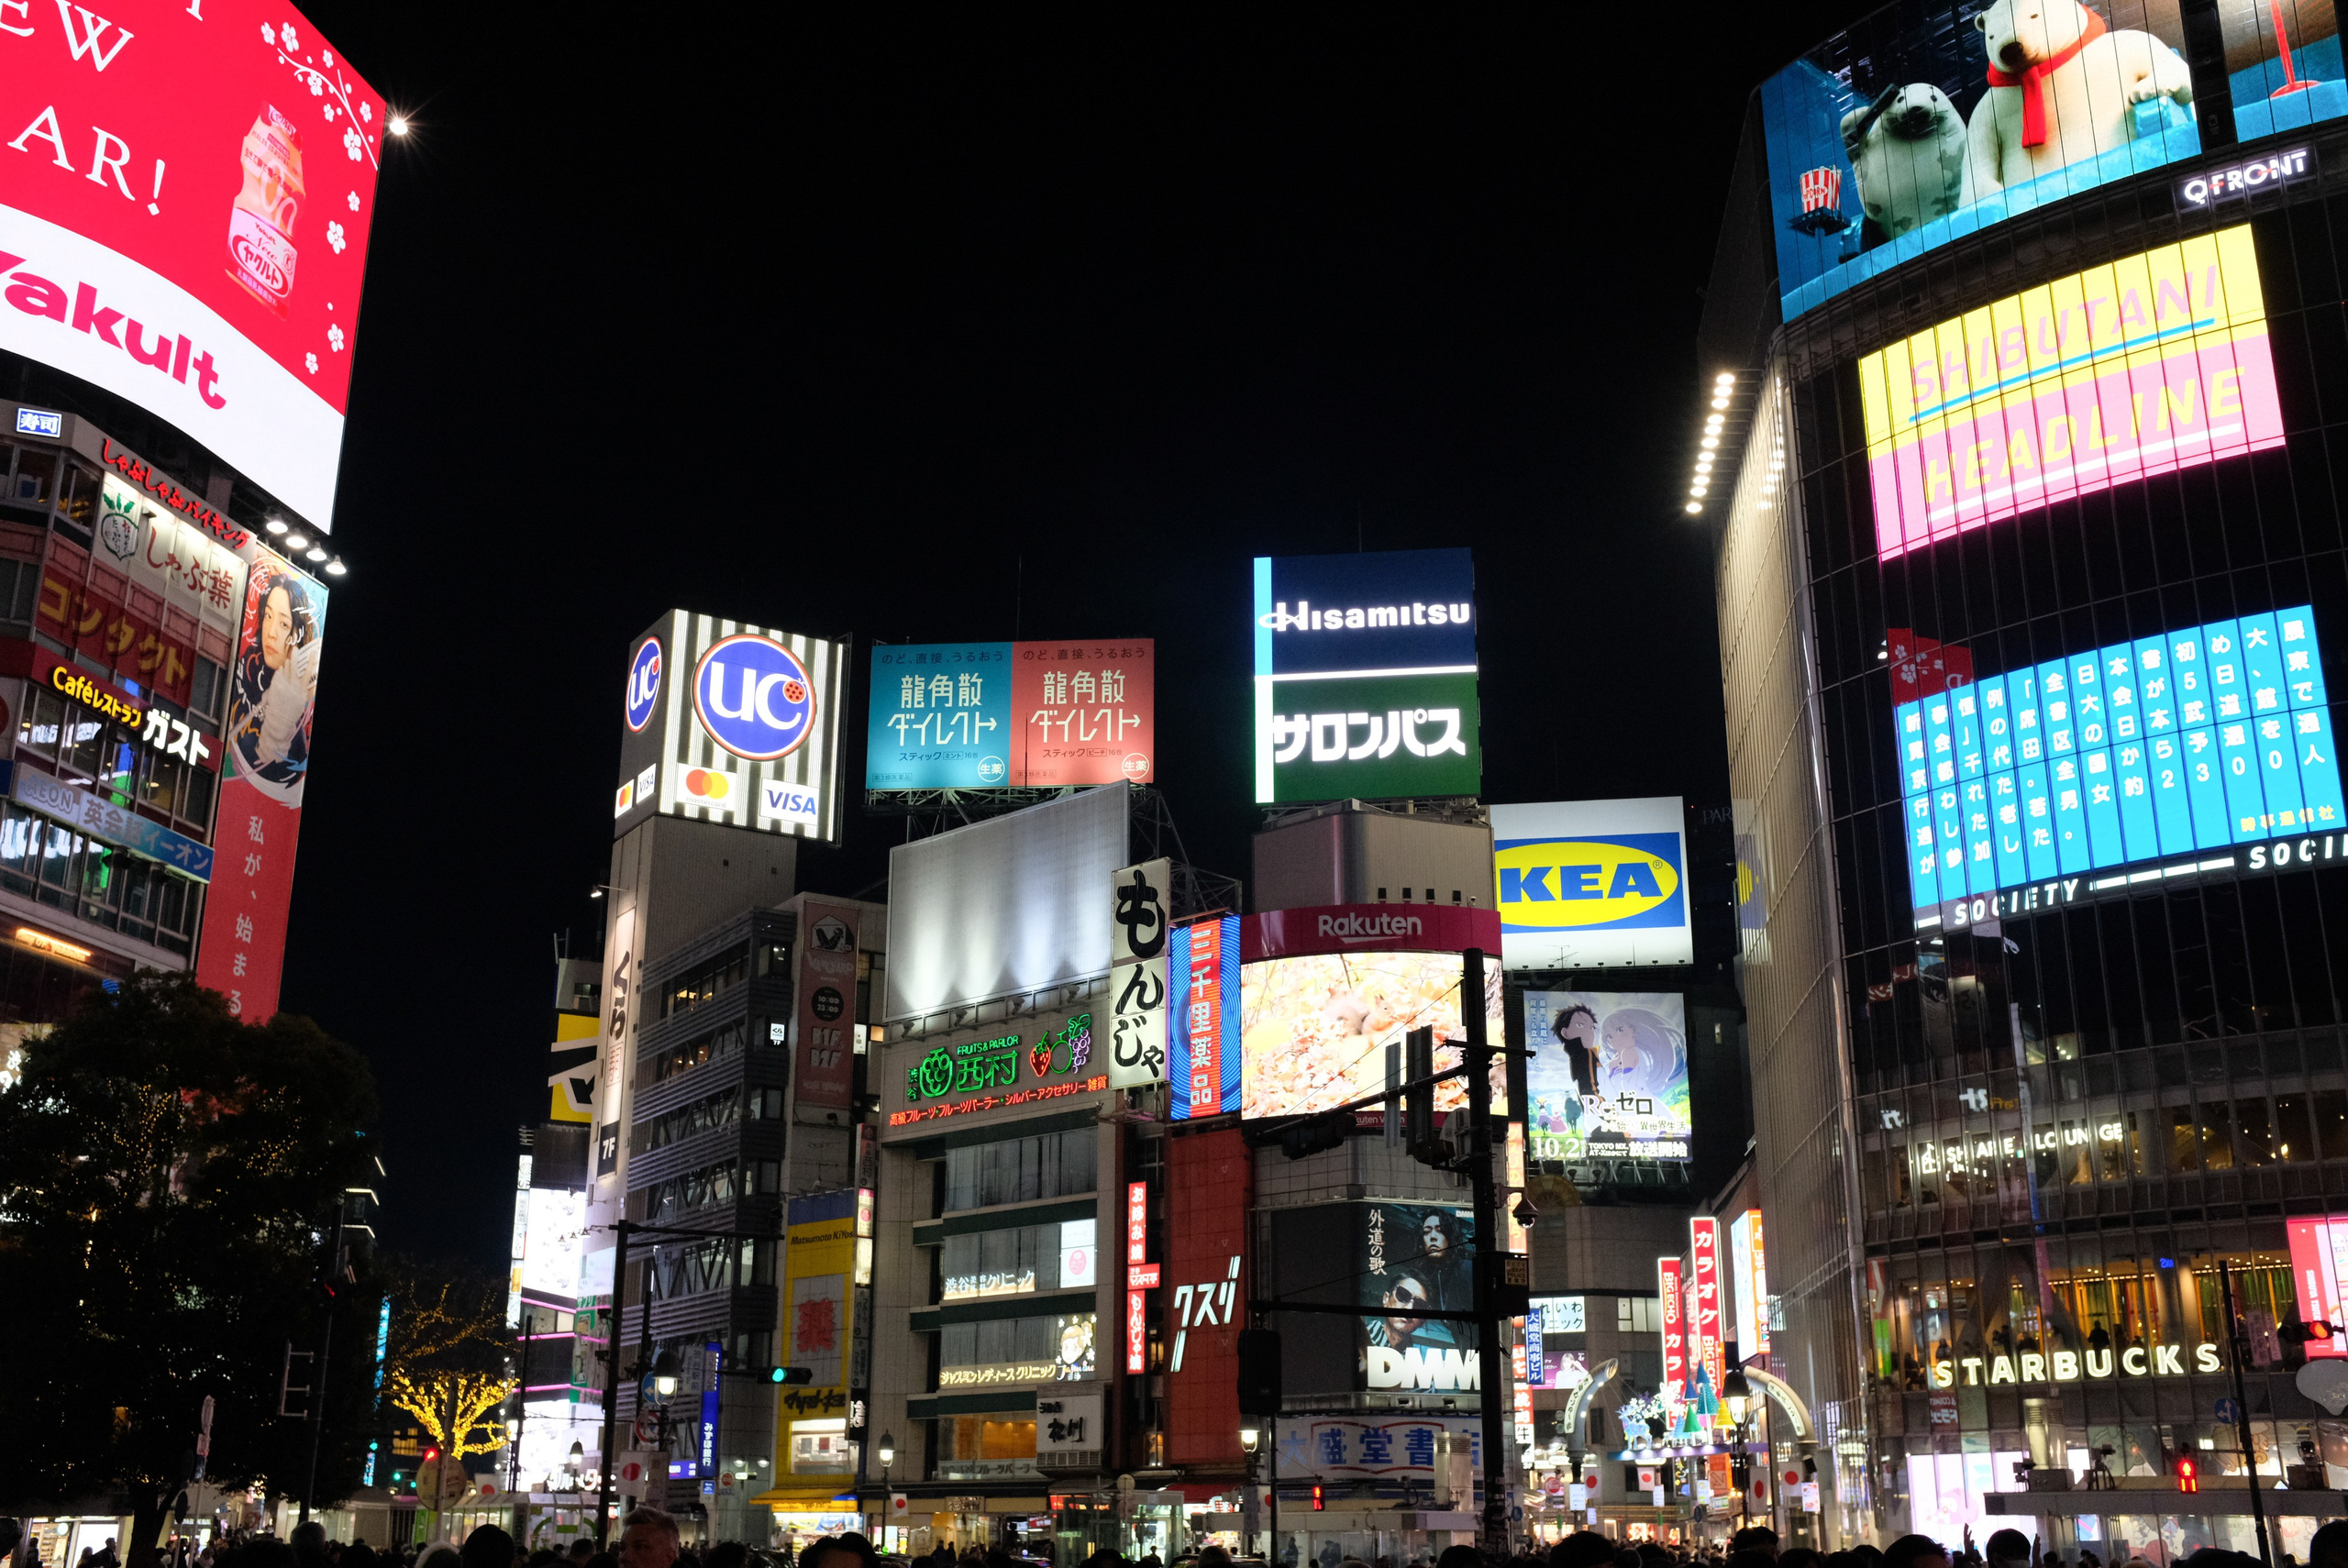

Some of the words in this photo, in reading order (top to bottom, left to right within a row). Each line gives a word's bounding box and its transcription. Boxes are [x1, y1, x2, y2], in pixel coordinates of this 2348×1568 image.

[2185, 151, 2308, 204] QFRONT
[243, 244, 279, 286] ヤクルト
[1909, 264, 2218, 404] SHIBUTANI
[20, 413, 59, 433] 寿司
[1925, 366, 2245, 504] HEADLINE
[102, 437, 251, 549] しゃぶしゃぶバイキング
[146, 525, 234, 610] しゃぶ葉
[39, 577, 187, 684] コンタクト
[1258, 601, 1470, 632] Hisamitsu
[881, 650, 1004, 664] のど、直接、うるおう
[1023, 646, 1146, 661] のど、直接、うるおう
[901, 672, 983, 709] 龍角散
[1043, 669, 1125, 705] 龍角散
[142, 708, 210, 766] ガスト
[887, 712, 998, 747] ダイレクト
[1030, 708, 1141, 743] ダイレクト
[1272, 708, 1467, 764] サロンパス
[899, 751, 942, 762] スティック
[980, 762, 1003, 775] 生薬
[1042, 747, 1086, 758] スティック
[1124, 759, 1147, 772] 生薬
[685, 795, 726, 809] mastercard
[764, 788, 817, 816] VISA
[83, 796, 210, 871] 英会話イーオン
[1921, 827, 2073, 874] が参加した。
[227, 815, 265, 1015] 私が、始まる
[1955, 878, 2078, 925] SOCIETY
[1319, 912, 1423, 938] Rakuten
[1113, 869, 1166, 1077] もんじゃ
[1190, 929, 1213, 1106] 三千里薬品
[957, 1050, 1018, 1091] 西村
[602, 1136, 615, 1160] 7F
[1534, 1137, 1580, 1158] 10.2
[1629, 1141, 1688, 1158] 放送開始
[791, 1232, 832, 1245] Matsumoto
[1368, 1209, 1388, 1276] 外道の歌
[1695, 1231, 1718, 1325] カラオケ
[1367, 1345, 1482, 1390] DMM
[1528, 1313, 1543, 1381] 大盛堂商事ビル
[1936, 1343, 2221, 1387] STARBUCKS
